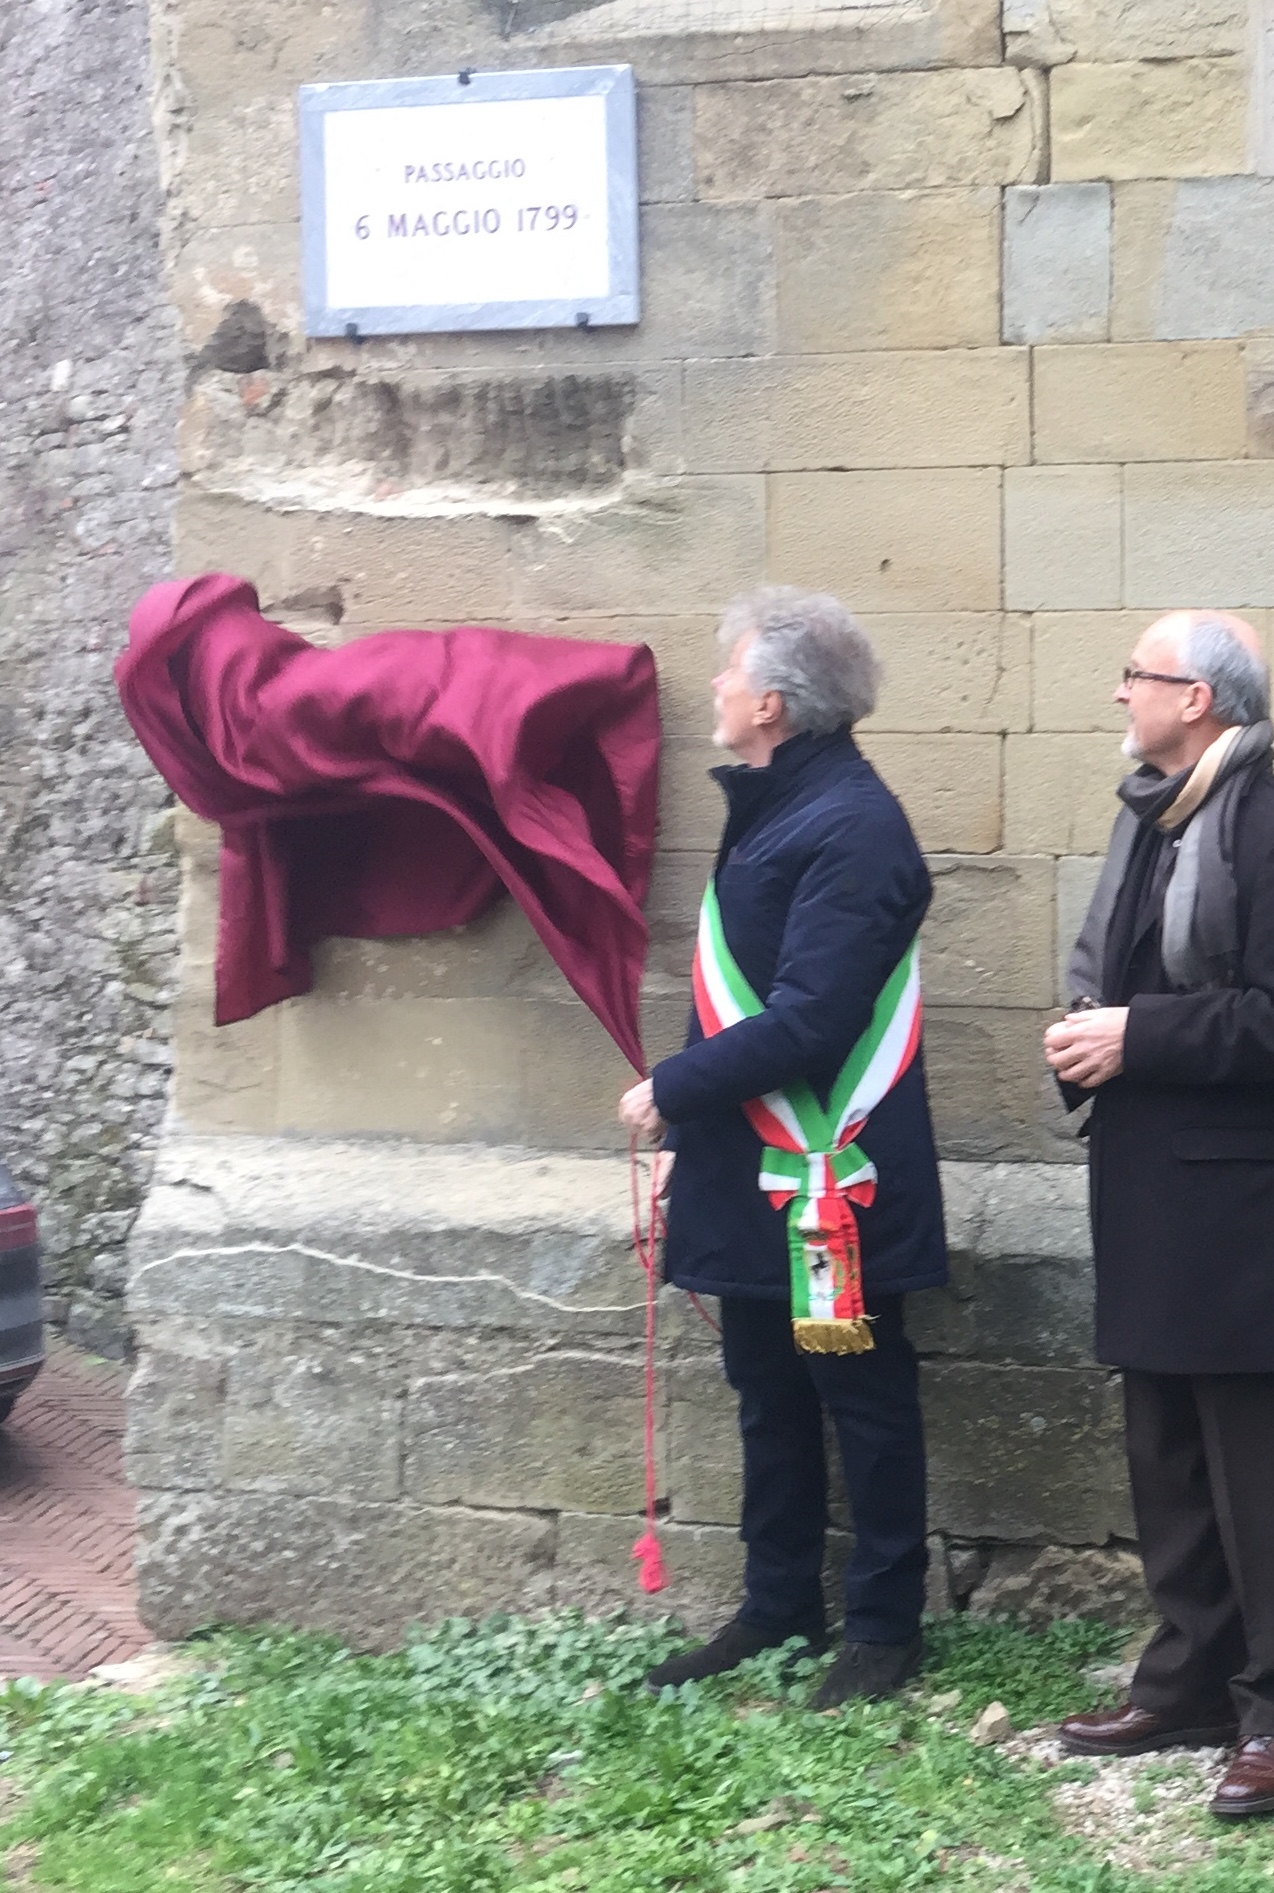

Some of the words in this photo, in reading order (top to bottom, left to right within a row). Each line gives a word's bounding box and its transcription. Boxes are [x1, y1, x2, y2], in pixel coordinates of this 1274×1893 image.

[403, 158, 526, 183] PASSAGGIO
[354, 215, 371, 240] 6
[387, 208, 501, 239] MAGGIO
[517, 203, 579, 234] 1799
